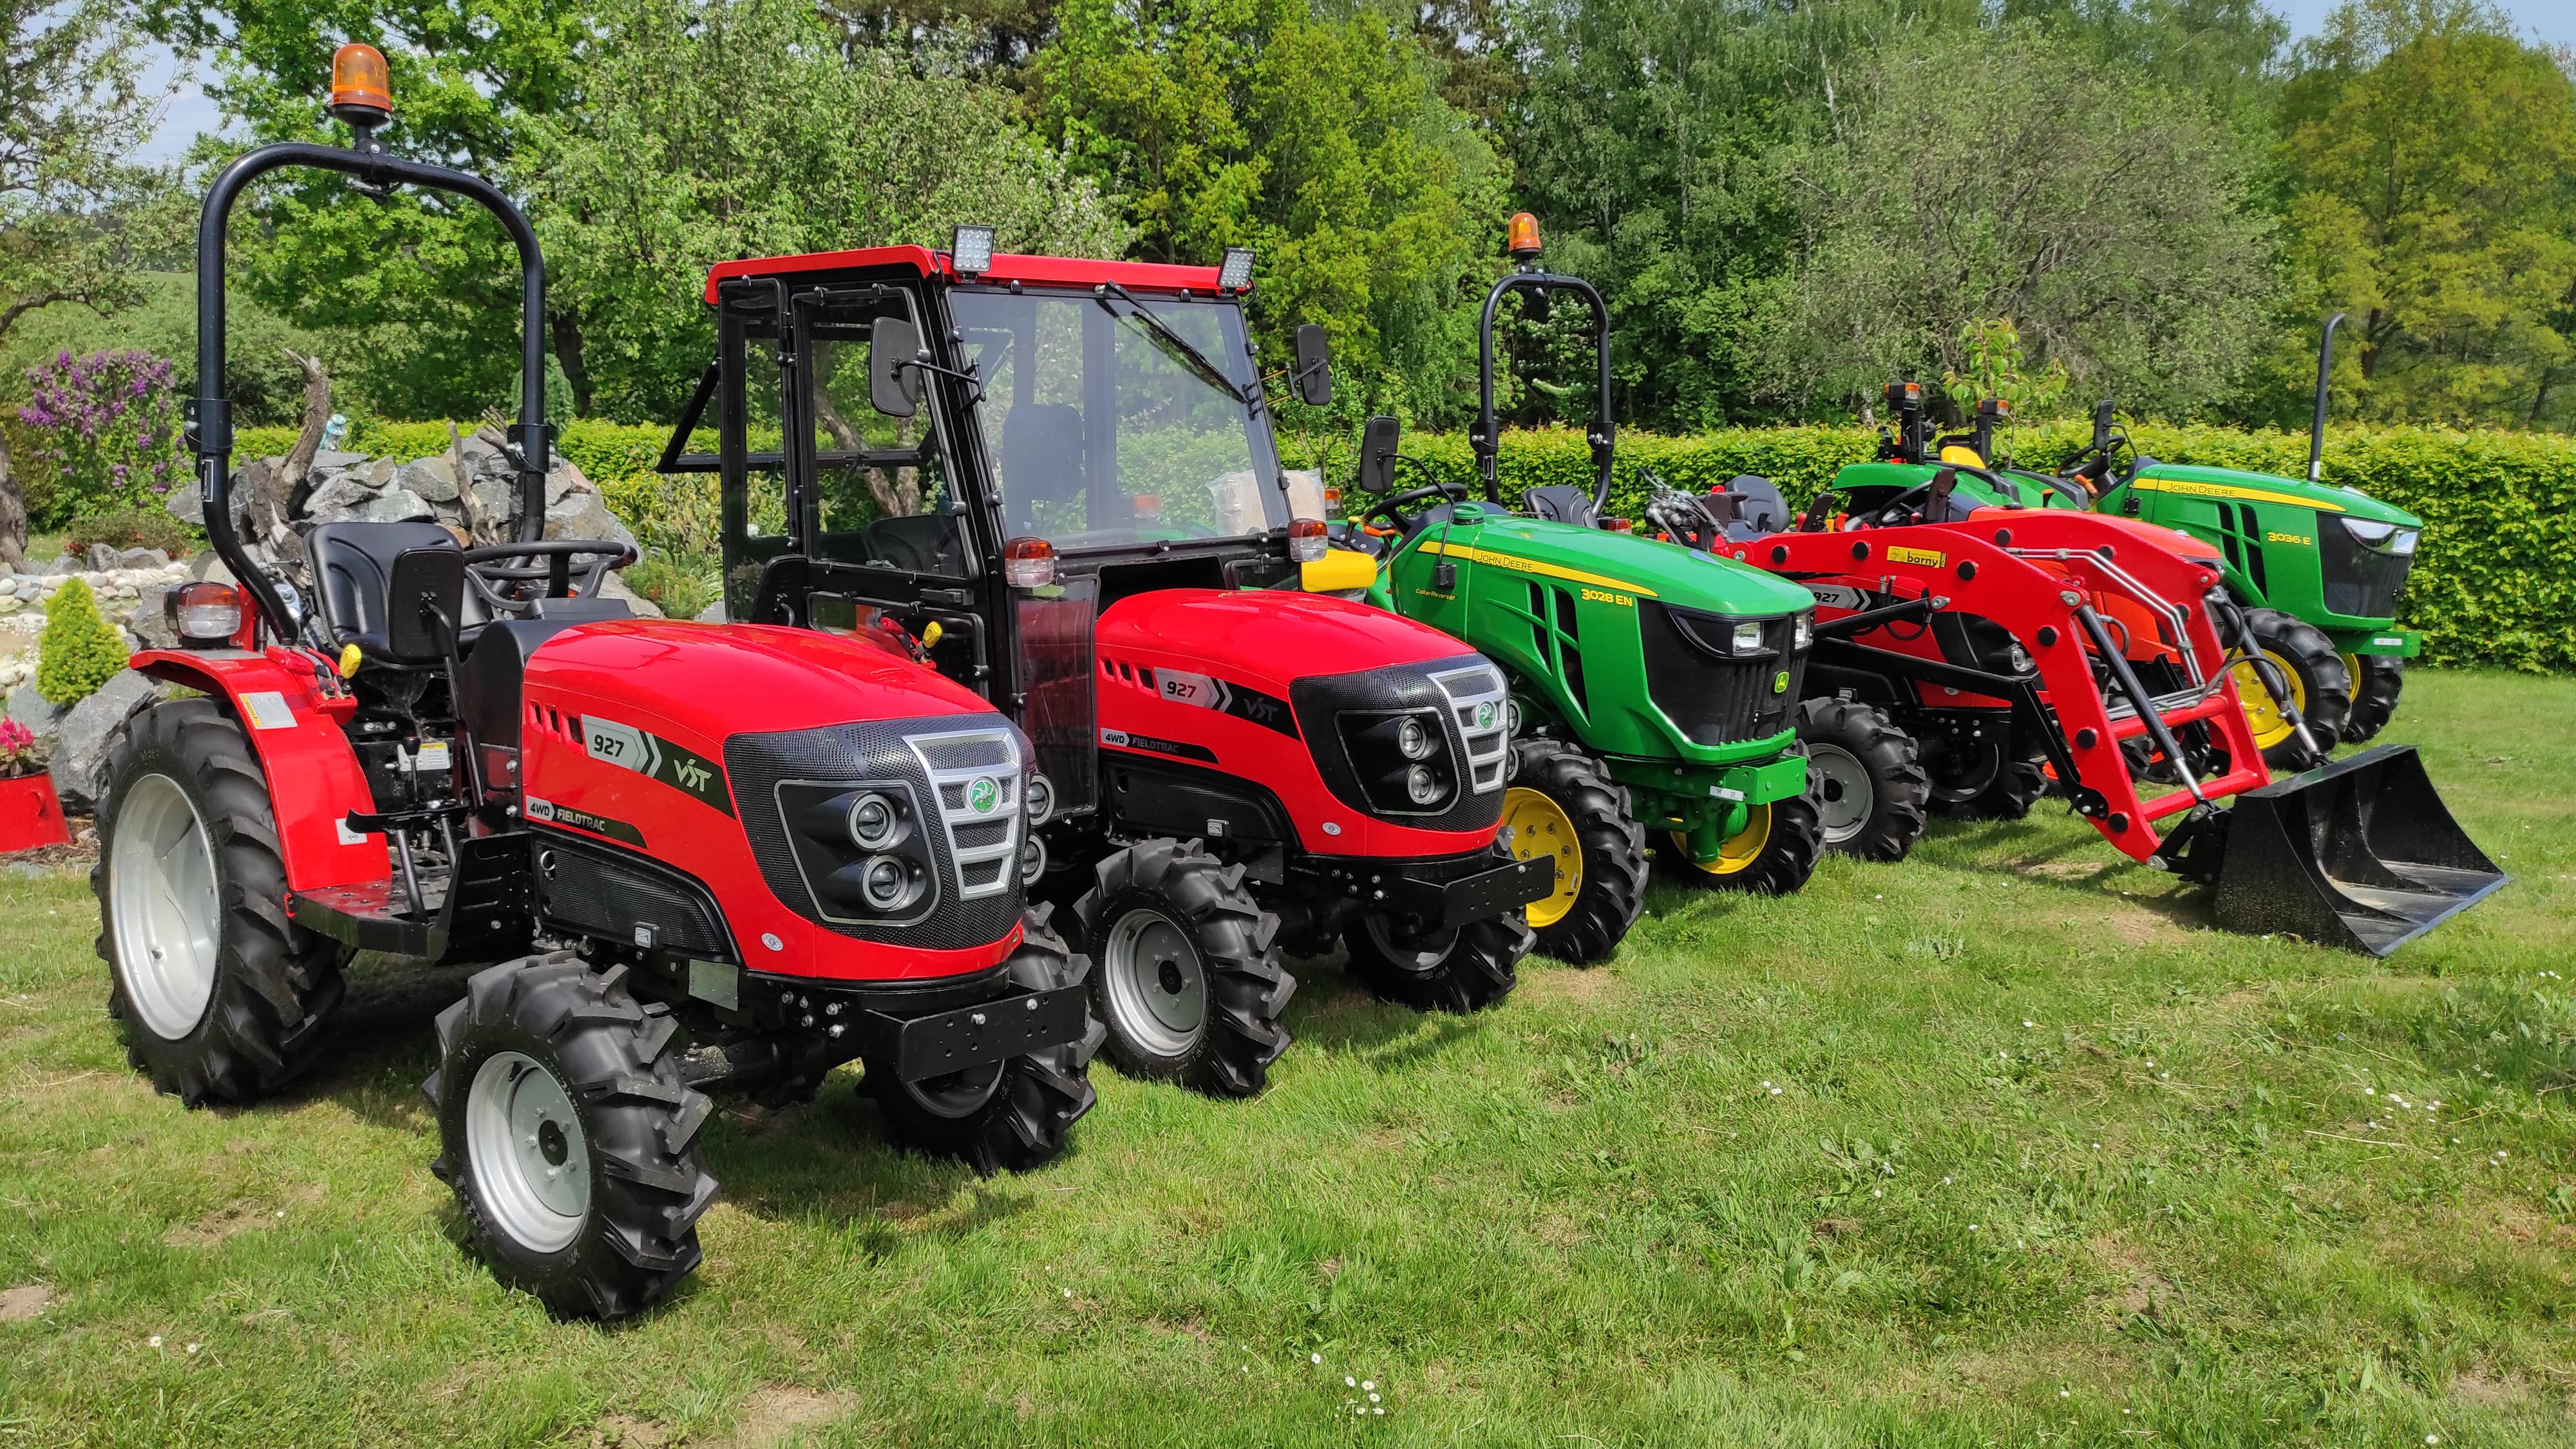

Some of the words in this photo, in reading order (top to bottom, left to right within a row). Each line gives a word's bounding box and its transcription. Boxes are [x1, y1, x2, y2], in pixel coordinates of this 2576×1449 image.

[2167, 483, 2197, 493] JOHN
[2199, 486, 2235, 497] DEERE
[2267, 532, 2301, 544] 3036
[2303, 536, 2311, 545] E
[1478, 553, 1501, 565] JOHN
[1503, 558, 1533, 571] DEERE
[1908, 551, 1938, 567] barny
[1581, 589, 1614, 603] 3028
[1615, 594, 1633, 607] EN
[1814, 592, 1840, 603] 927
[1167, 681, 1197, 698] 927
[1244, 697, 1279, 722] VST
[594, 734, 624, 757] 927
[1105, 733, 1125, 744] 4WD
[1132, 737, 1179, 753] FIELDTRAC
[674, 758, 712, 792] VST
[530, 802, 549, 817] 4WD
[557, 808, 605, 831] FIELDTRAC
